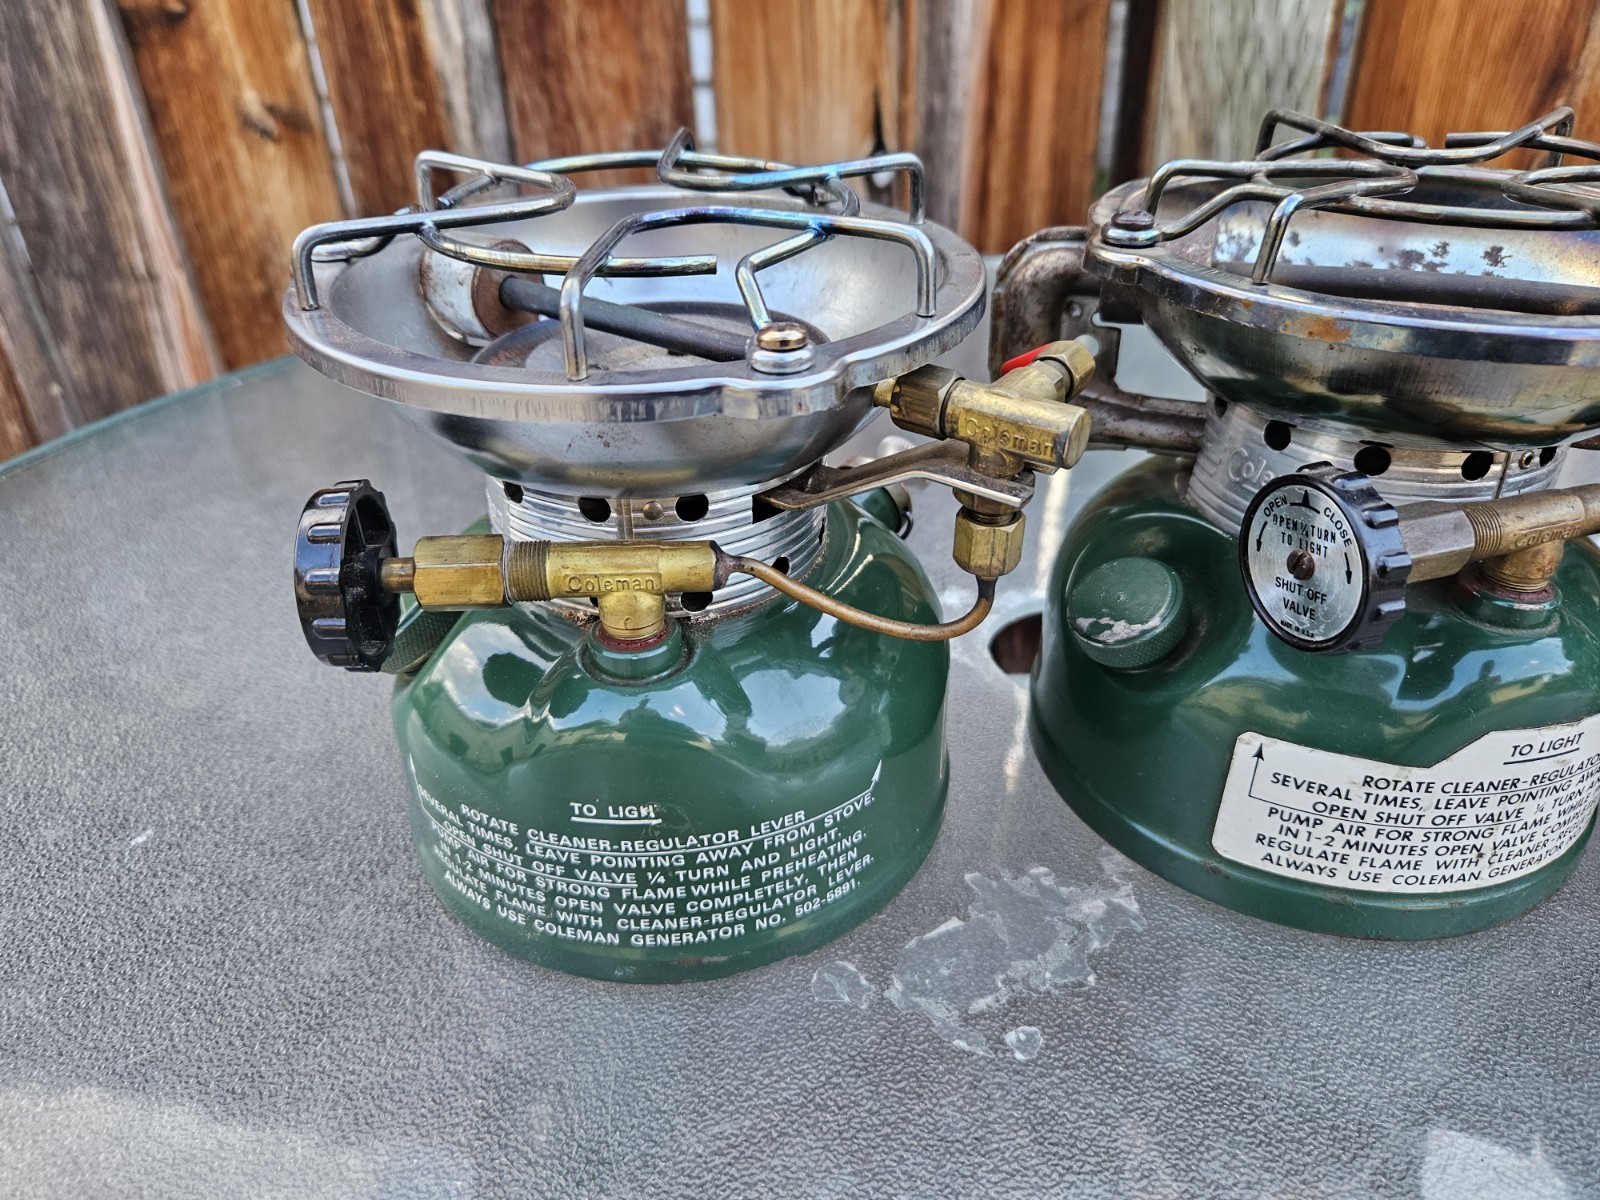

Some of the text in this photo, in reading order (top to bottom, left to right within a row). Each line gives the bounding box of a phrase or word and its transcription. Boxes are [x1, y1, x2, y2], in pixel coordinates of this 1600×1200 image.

[965, 416, 1056, 458] Coleman
[1263, 494, 1289, 517] OPEN
[1272, 514, 1299, 530] OPEN
[1311, 524, 1337, 545] TURN
[1280, 531, 1329, 558] TO LIGHT
[1323, 506, 1353, 548] CLOSE
[1514, 526, 1581, 548] Coleman
[567, 575, 656, 593] Coleman
[1274, 576, 1328, 605] SHUT OFF
[1280, 619, 1293, 631] MADE
[1294, 625, 1301, 633] IN
[1282, 596, 1316, 621] VALVE
[1510, 731, 1585, 758] TO LIGHT
[1270, 772, 1353, 802] SEVERAL
[1362, 792, 1425, 812] TIMES,
[1434, 796, 1491, 811] LEAVE
[1497, 779, 1573, 808] POINTING
[1361, 774, 1436, 794] ROTATE
[1441, 752, 1600, 795] CLEANER-REGULATO
[417, 784, 876, 869] SEVERAL TIMES, LEAVE POINTING AWAY FROM STOVE.
[569, 802, 659, 819] TO LIGH
[1267, 806, 1324, 829] PUMP
[1332, 822, 1367, 838] AIR
[1374, 828, 1414, 842] FOR
[1421, 827, 1495, 843] STRONG
[1501, 814, 1551, 837] FLAME
[1557, 791, 1592, 819] WHILE
[1312, 801, 1368, 821] OPEN
[1374, 811, 1426, 827] SHUT
[1430, 814, 1467, 827] OFF
[1475, 807, 1525, 825] VALVE
[1551, 786, 1586, 810] TURN
[460, 803, 806, 853] ROTATE CLEANER-REGULATOR LEVER
[1278, 824, 1300, 839] IN
[1305, 830, 1335, 847] 1-2
[1342, 839, 1427, 856] MINUTES
[1434, 843, 1484, 857] OPEN
[1493, 830, 1538, 852] VALVE
[430, 820, 868, 900] PUMP AIR FOR STRONG FLAME WHILE PREHEATING.
[443, 820, 476, 848] OPEN
[483, 842, 524, 867] SHUT
[532, 861, 565, 877] OFF
[575, 868, 638, 885] VALVE
[674, 864, 730, 883] TURN
[740, 852, 781, 873] AND
[790, 827, 842, 858] LIGHT.
[1255, 833, 1350, 865] REGULATE
[1358, 856, 1424, 872] FLAME
[1436, 857, 1481, 872] WITH
[1260, 852, 1338, 879] ALWAYS
[1348, 870, 1383, 884] USE
[1392, 870, 1482, 887] COLEMAN
[1488, 841, 1565, 879] GENERATOR
[433, 844, 875, 932] REGULATE FLAME WITH CLEANER-REGULATOR LEVER.
[440, 840, 451, 856] IN
[478, 868, 547, 902] MINUTES
[554, 896, 604, 914] OPEN
[613, 902, 676, 916] VALVE
[816, 847, 859, 877] THEN
[443, 869, 862, 947] ALWAYS USE COLEMAN GENERATOR NO. 502-5891.
